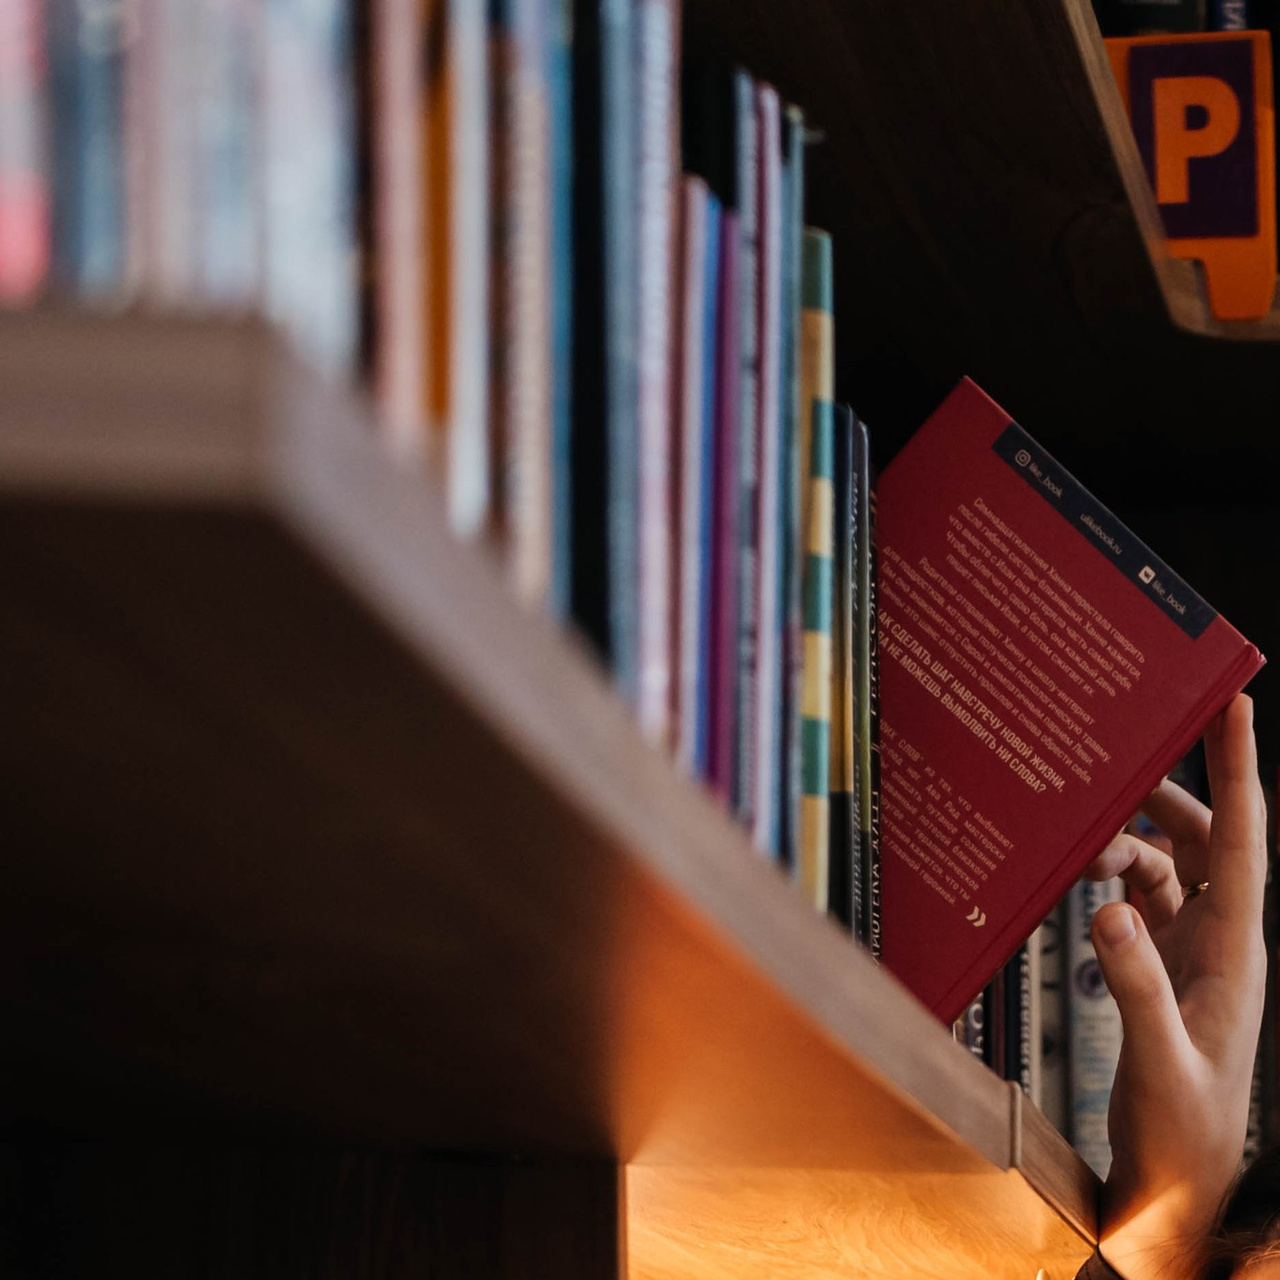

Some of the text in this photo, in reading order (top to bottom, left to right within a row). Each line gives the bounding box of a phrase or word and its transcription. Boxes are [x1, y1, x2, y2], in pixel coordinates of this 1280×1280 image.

[1026, 462, 1065, 499] like_book
[1078, 511, 1125, 555] ulikebook.ru
[879, 544, 902, 566] для
[942, 602, 981, 640] которые
[975, 633, 1018, 675] получили
[1012, 668, 1085, 737] психологическую
[915, 557, 959, 599] Родители
[953, 591, 1005, 641] отправляют
[999, 635, 1029, 664] Ханну
[1028, 662, 1097, 727] школу-интернат
[941, 530, 972, 561] Чтобы
[966, 554, 1012, 597] облегчить
[1006, 591, 1032, 616] свою
[1047, 630, 1068, 650] она
[1062, 643, 1100, 680] каждый
[1094, 673, 1120, 698] день
[943, 552, 974, 582] пишет
[969, 576, 1003, 609] письма
[1024, 628, 1054, 657] потом
[1048, 650, 1086, 687] сжигает
[944, 513, 965, 533] что
[959, 527, 993, 560] вместе
[1012, 576, 1032, 596] она
[1026, 590, 1068, 630] потеряла
[1062, 623, 1091, 651] часть
[1085, 645, 1115, 674] самой
[954, 502, 984, 531] после
[977, 524, 1012, 557] гибели
[1080, 620, 1110, 649] Ханне
[970, 496, 1150, 664] Семнадцатилетняя Ханна перестала говорить
[1149, 579, 1188, 616] like_book
[877, 560, 898, 581] Там
[891, 574, 913, 595] она
[906, 588, 958, 637] знакомится
[957, 636, 987, 665] Сарой
[987, 663, 1047, 721] симпатичным
[1041, 714, 1076, 748] парнем
[884, 642, 903, 661] НЕ
[897, 653, 945, 699] МОЖЕШЬ
[938, 692, 1000, 751] ВЫМОЛВИТЬ
[993, 744, 1013, 764] НИ
[1006, 756, 1048, 796] СЛОВА?
[887, 622, 935, 668] СДЕЛАТЬ
[926, 659, 954, 686] ШАГ
[946, 677, 1004, 733] НАВСТРЕЧУ
[996, 724, 1034, 761] НОВОЙ
[1026, 752, 1070, 794] ЖИЗНИ,
[900, 602, 921, 624] это
[914, 616, 942, 643] шанс
[935, 635, 981, 680] отпустить
[974, 672, 1016, 712] прошлое
[1015, 710, 1045, 739] снова
[1038, 731, 1076, 767] обрести
[874, 718, 897, 740] ОИХ
[922, 763, 938, 778] из
[955, 793, 974, 813] что
[972, 809, 1016, 852] выбивают
[889, 769, 925, 803] описать
[958, 834, 998, 872] сознание
[917, 812, 953, 847] потерей
[950, 843, 991, 882] близкого
[923, 782, 943, 802] Ава
[942, 800, 962, 820] Рид
[962, 818, 1008, 862] мастерски
[885, 839, 921, 873] главной
[912, 827, 981, 892] терапевтическое
